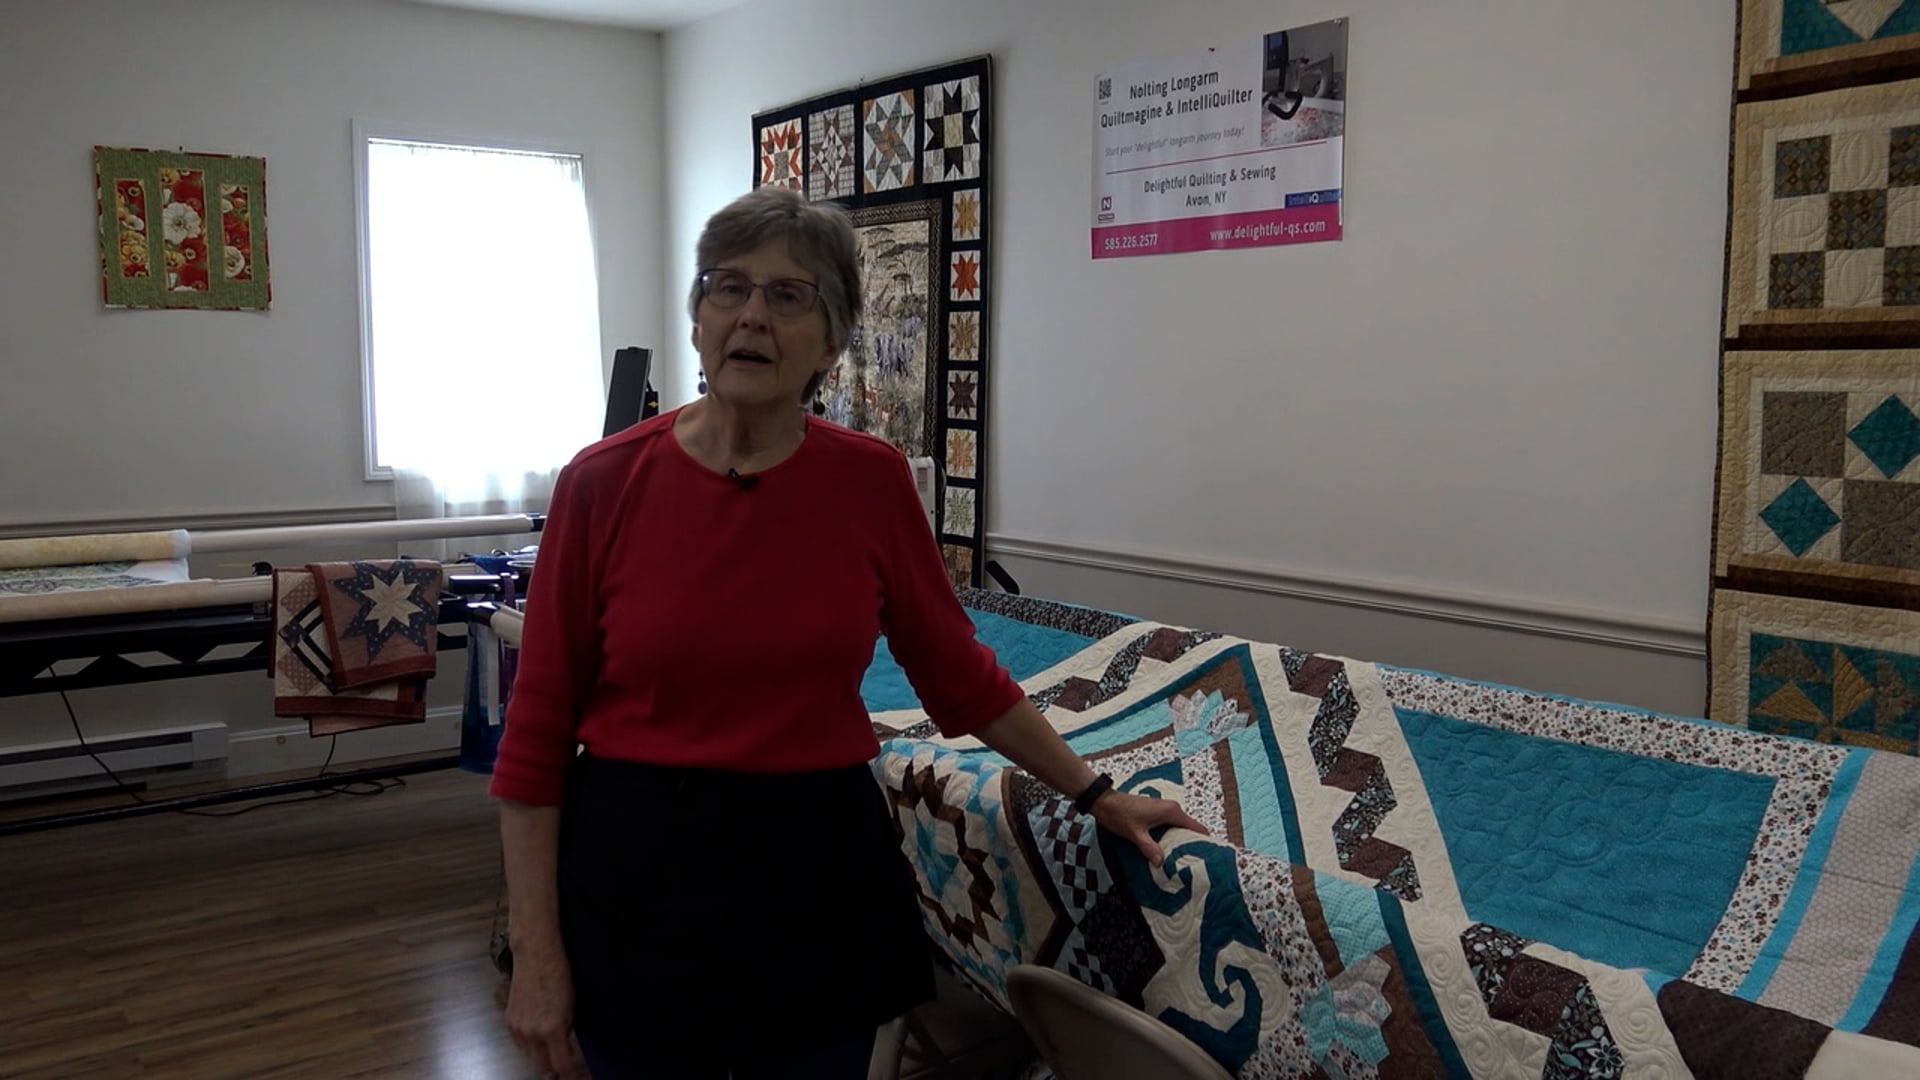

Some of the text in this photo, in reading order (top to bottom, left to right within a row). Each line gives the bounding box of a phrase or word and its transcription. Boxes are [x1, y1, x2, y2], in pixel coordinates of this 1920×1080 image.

[1129, 71, 1219, 100] Nolting Longarm
[1100, 89, 1253, 128] Quiltmagine & IntelliQuilter
[1120, 145, 1134, 156] your
[1169, 134, 1196, 148] longarm
[1196, 131, 1222, 146] journey
[1144, 166, 1277, 194] Delightful Quilting & Sewing
[1185, 191, 1228, 207] Avon, NY
[1104, 234, 1159, 250] 585.226.2577
[1210, 221, 1326, 241] www.delightful-qs.com
